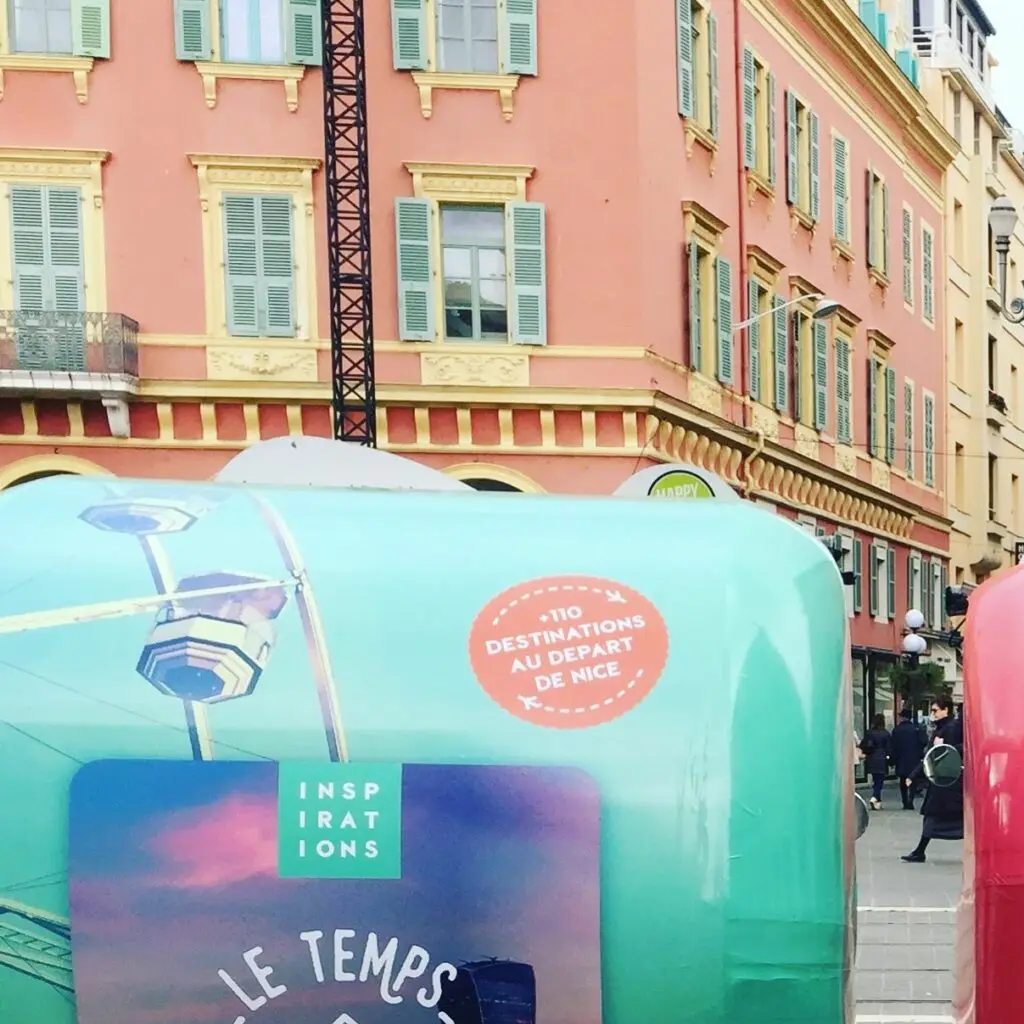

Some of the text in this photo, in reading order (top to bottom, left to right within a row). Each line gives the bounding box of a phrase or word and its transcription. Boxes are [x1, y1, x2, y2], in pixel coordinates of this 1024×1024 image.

[538, 605, 583, 623] +110
[485, 614, 646, 655] DESTINATIONS
[511, 636, 634, 673] AU DEPART
[534, 661, 622, 692] DE NICE
[299, 781, 380, 800] INSP
[299, 810, 379, 829] IRAT
[299, 839, 379, 858] IONS
[217, 928, 458, 1011] LE TEMPS
